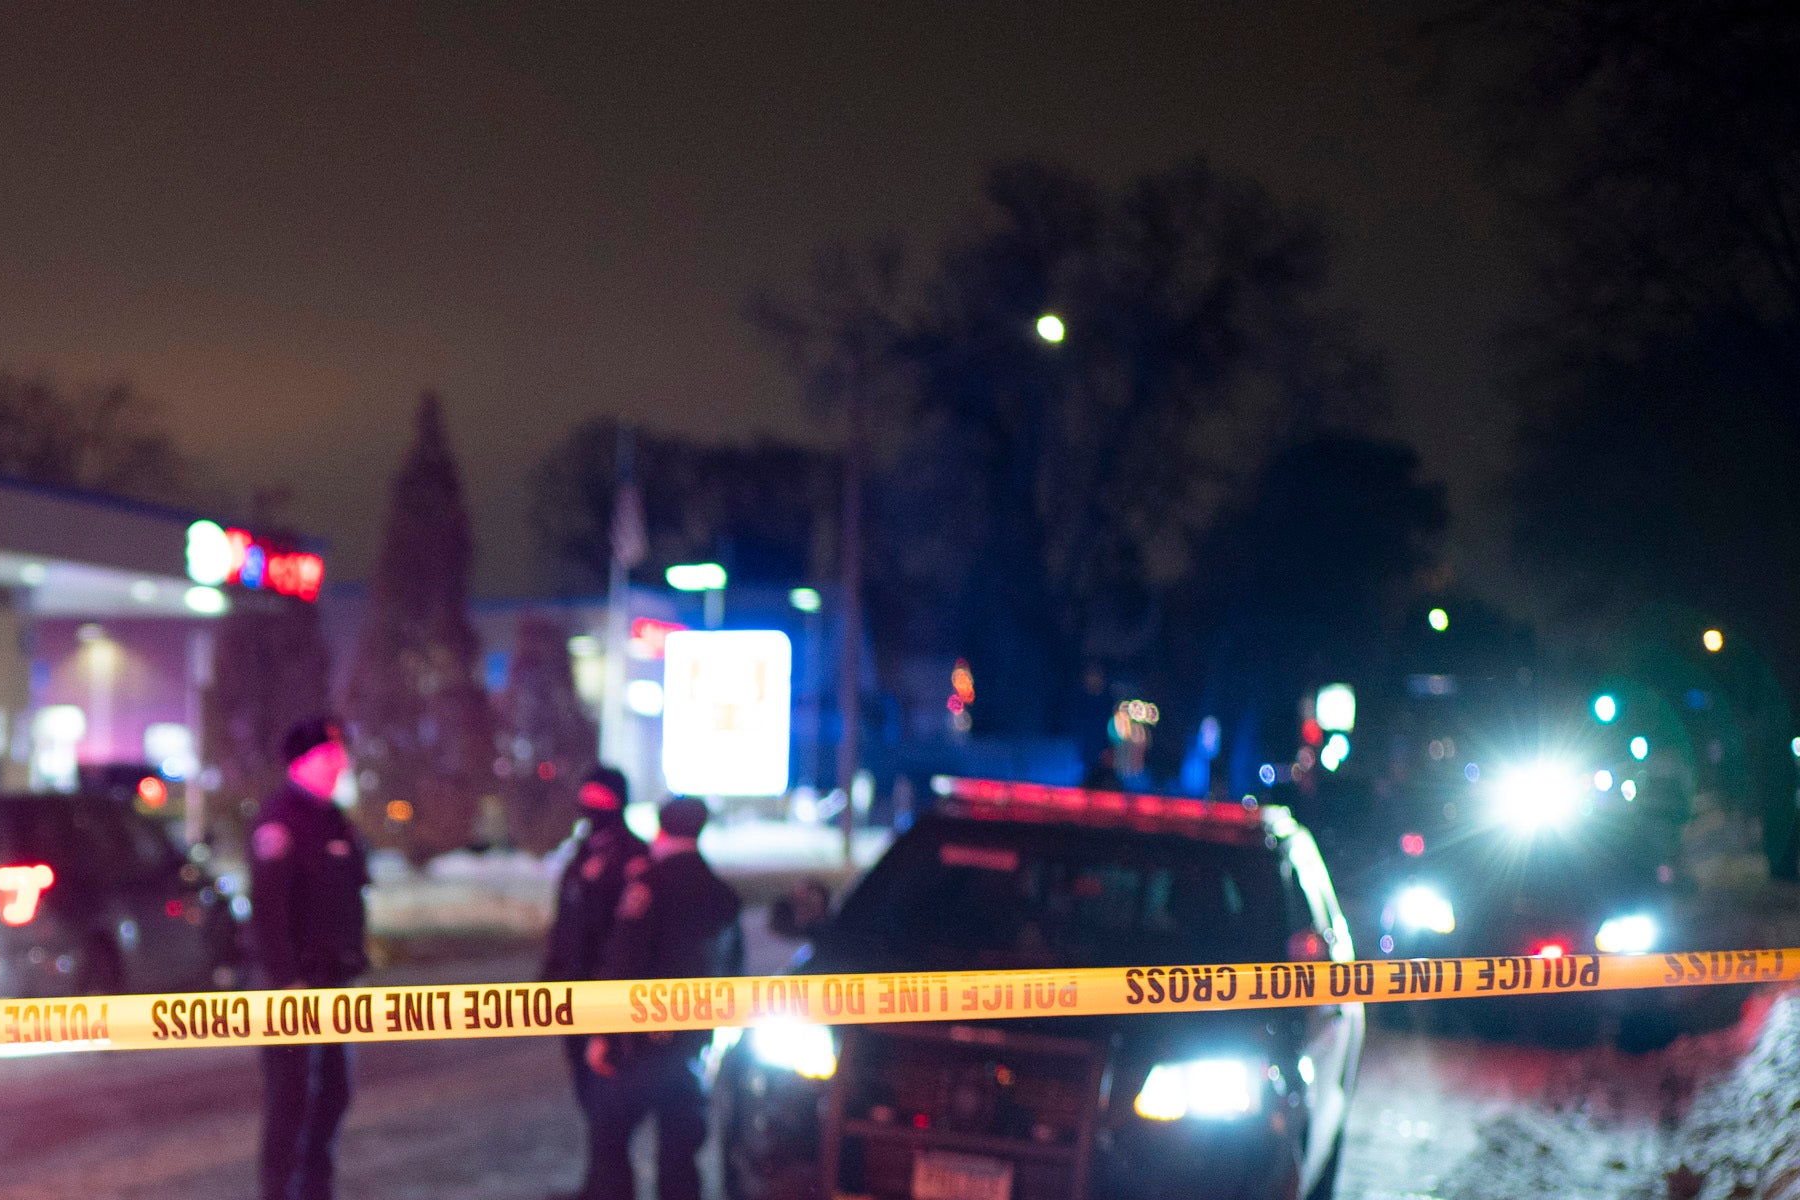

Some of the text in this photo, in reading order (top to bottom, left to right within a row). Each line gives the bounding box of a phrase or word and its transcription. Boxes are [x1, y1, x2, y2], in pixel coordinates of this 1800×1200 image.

[1126, 955, 1600, 1005] POLICE LINE DO NOT CROSS
[1663, 950, 1783, 984] CROSS
[152, 987, 574, 1040] POLICE LINE DO NOT CROSS
[630, 972, 1078, 1023] POLICE LINE DO NOT CROSS
[4, 1003, 110, 1045] POLICE
